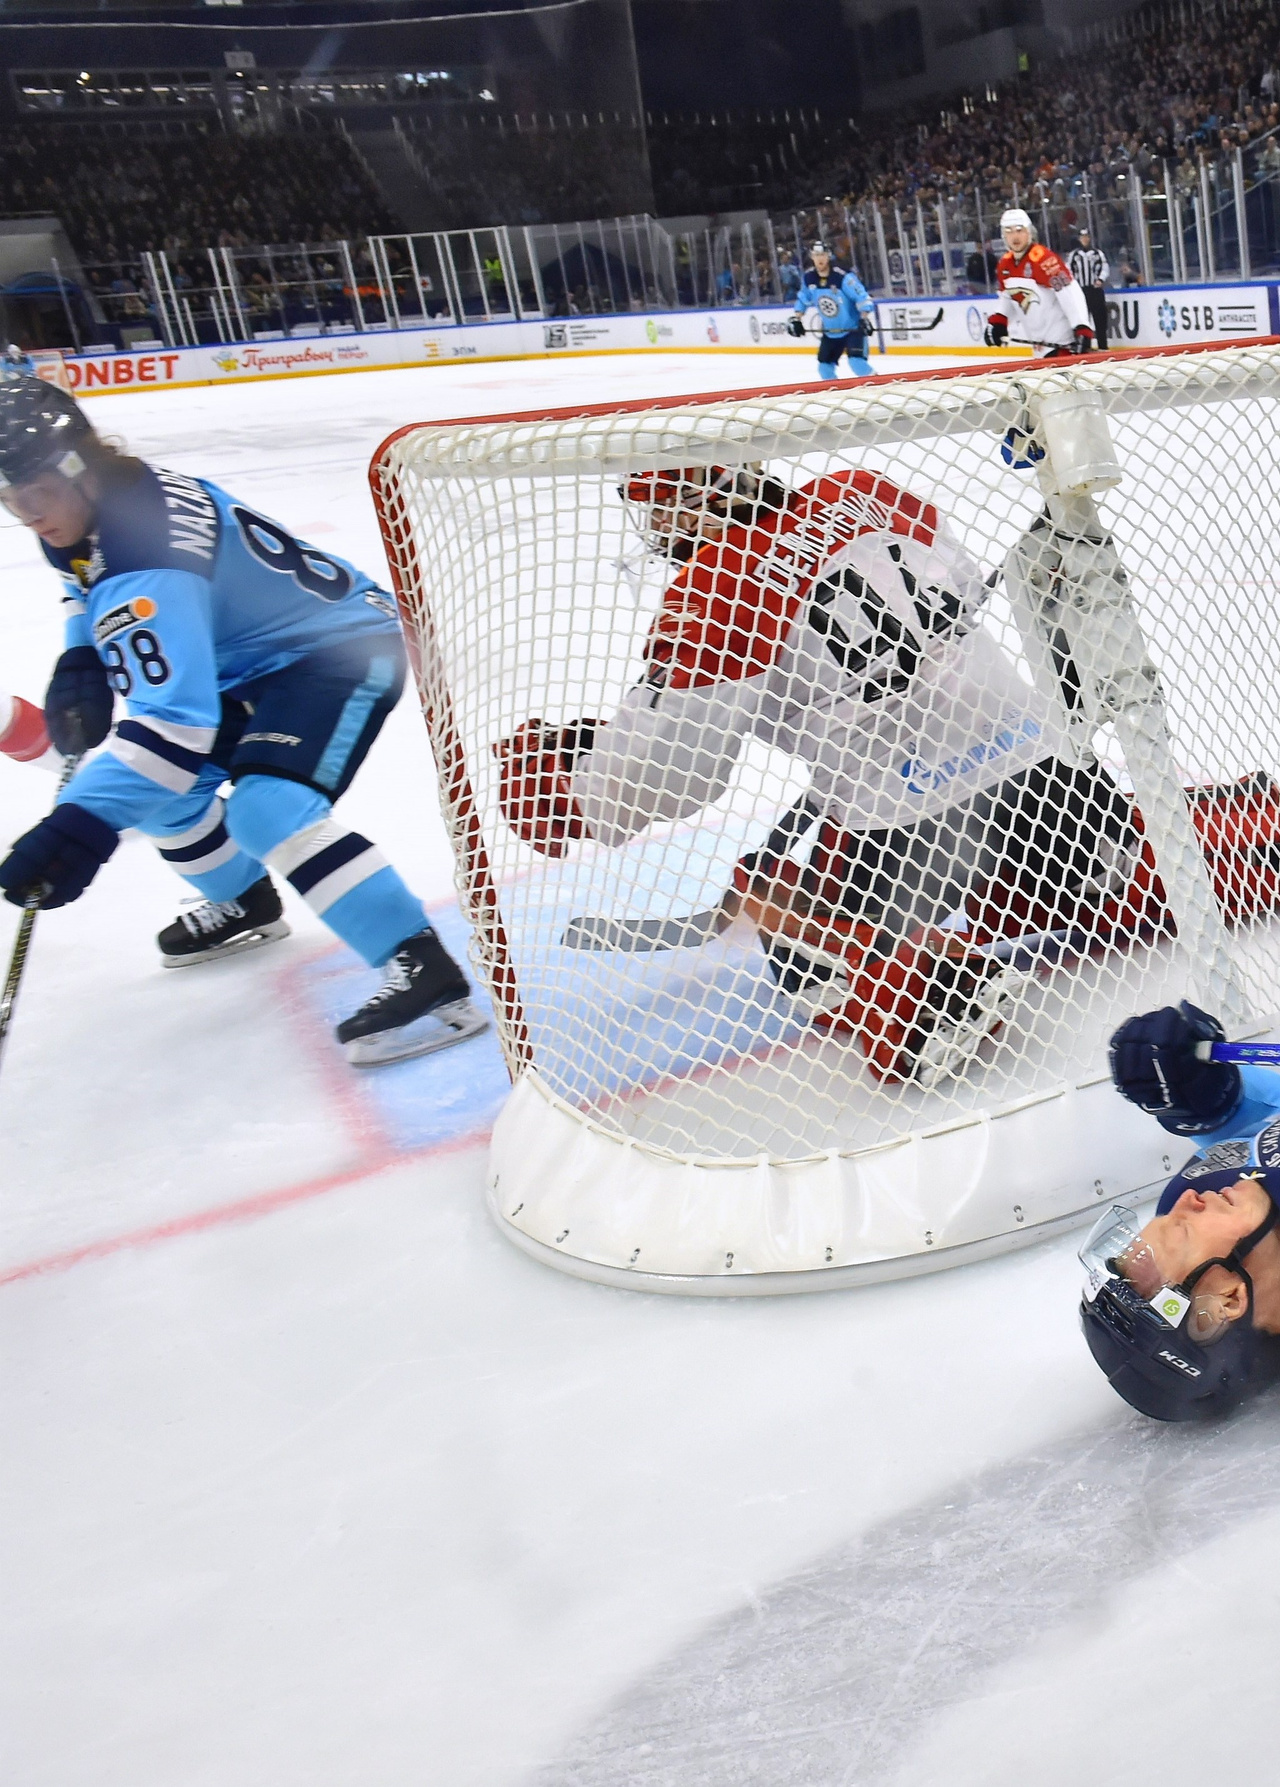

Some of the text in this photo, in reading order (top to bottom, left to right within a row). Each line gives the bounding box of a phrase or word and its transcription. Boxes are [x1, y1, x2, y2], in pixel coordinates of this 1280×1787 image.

[1181, 306, 1214, 331] SIB
[1219, 313, 1258, 324] ANTHRACITE
[1158, 1350, 1202, 1378] CCM
